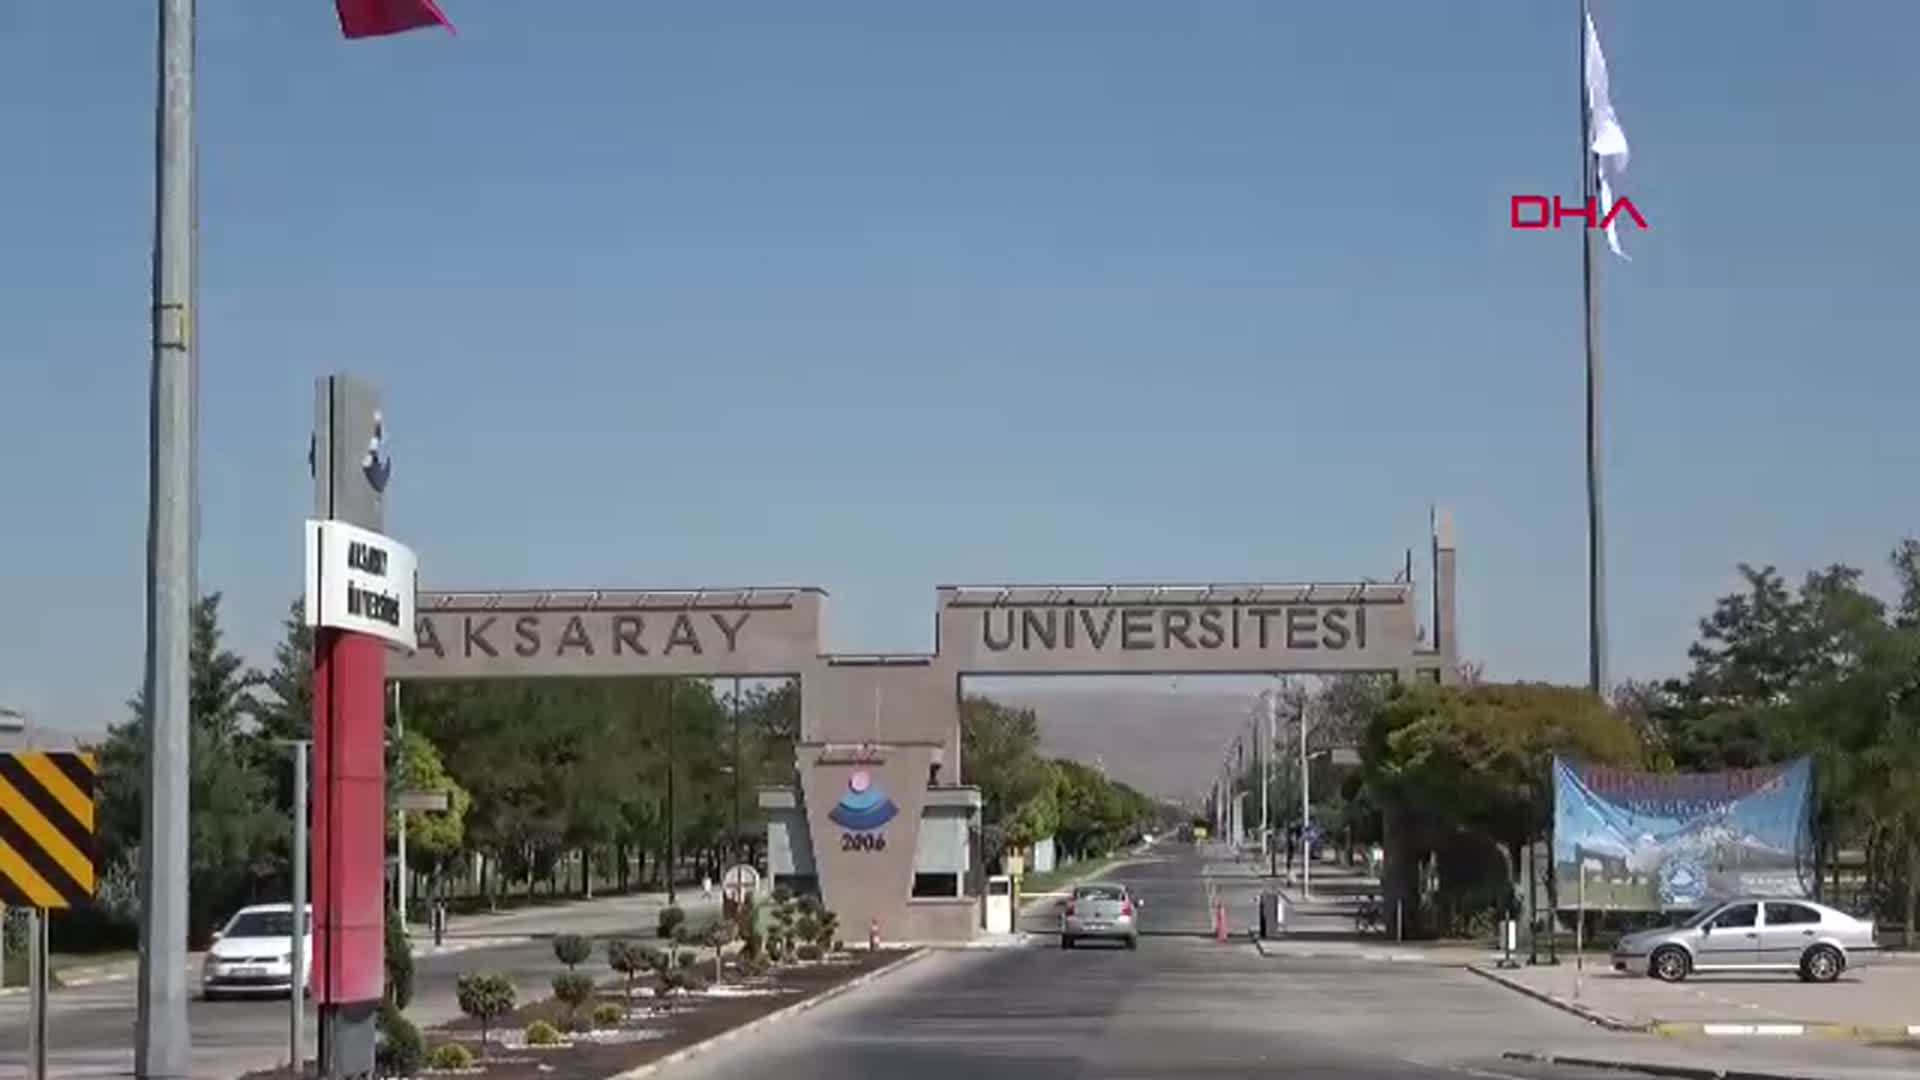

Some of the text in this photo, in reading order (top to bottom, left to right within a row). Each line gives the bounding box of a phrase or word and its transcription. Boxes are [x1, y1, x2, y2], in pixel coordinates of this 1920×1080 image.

[408, 612, 751, 657] AKSARAY
[983, 600, 1366, 651] ÜNİVERSİTESİ
[841, 832, 886, 852] 2006
